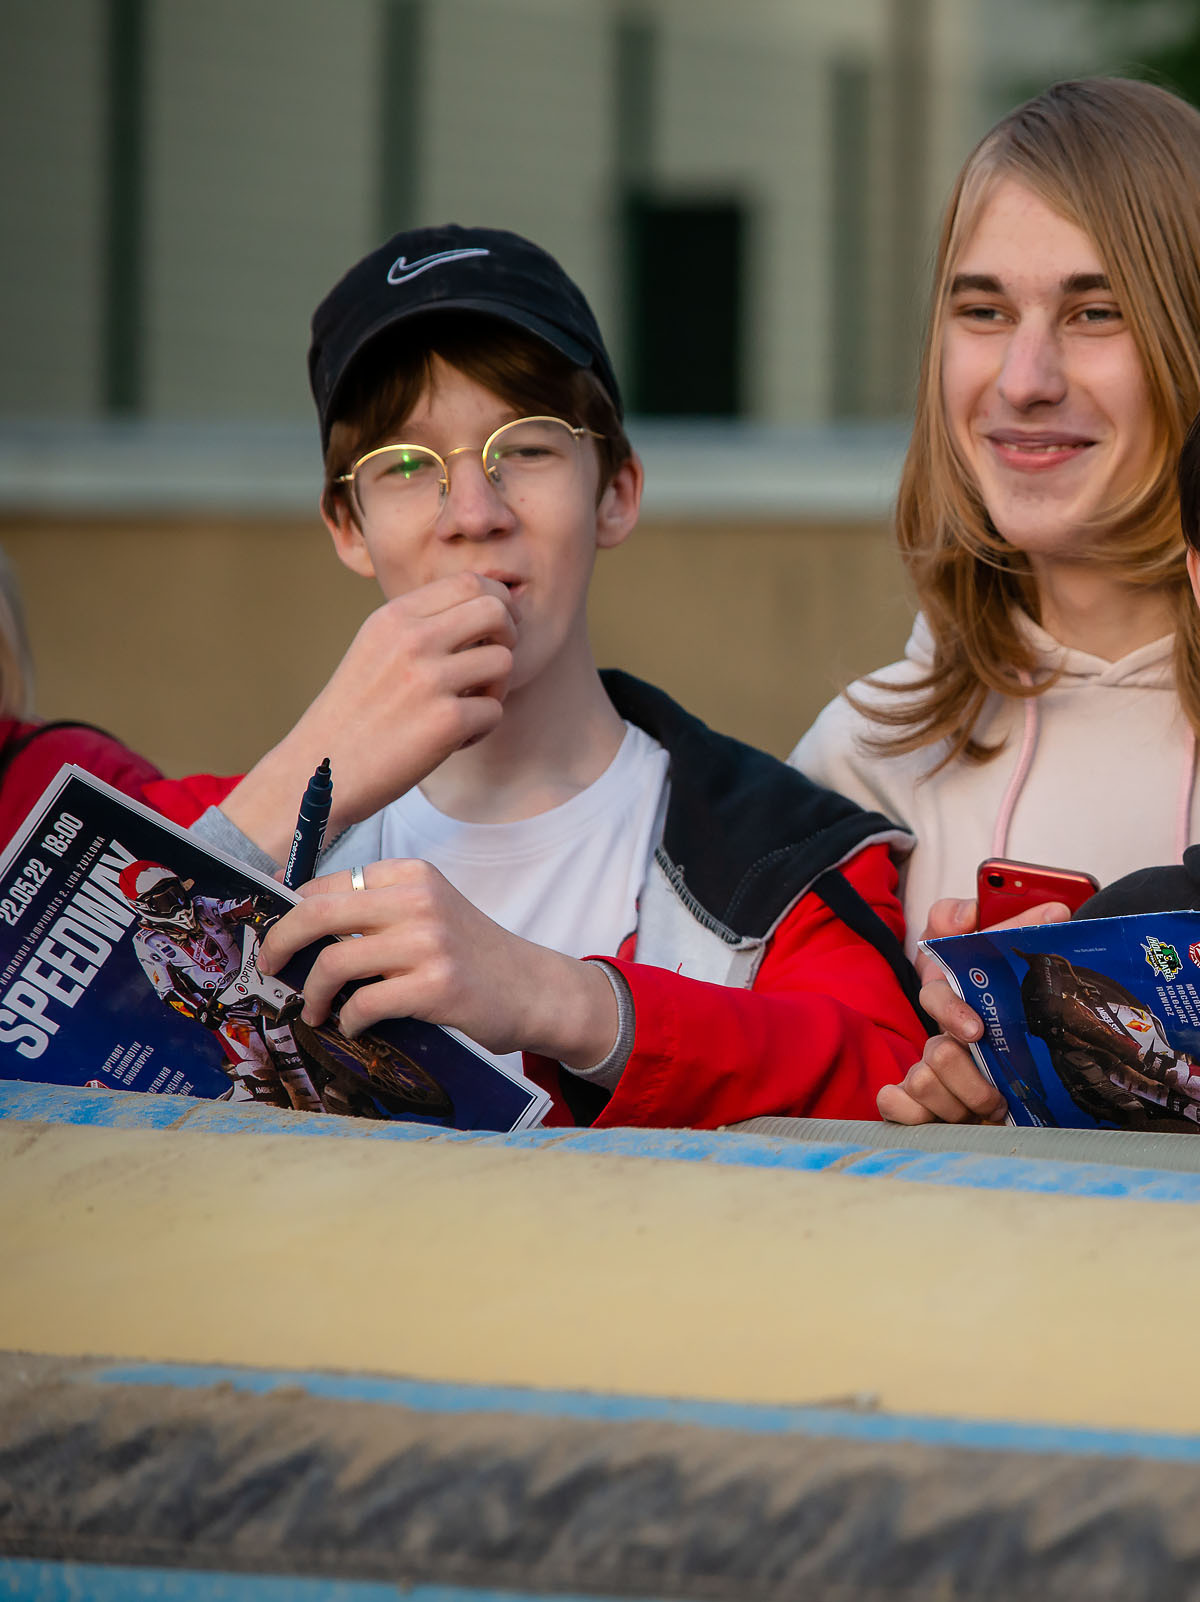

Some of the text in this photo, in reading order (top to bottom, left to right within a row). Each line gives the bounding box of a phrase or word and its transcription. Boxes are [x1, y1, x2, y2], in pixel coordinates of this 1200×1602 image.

[0, 812, 84, 926] 22.05.22 18:00
[64, 871, 82, 888] LIGA
[982, 992, 1010, 1053] OPTIBET
[112, 1041, 142, 1080] LOKOMOTIV
